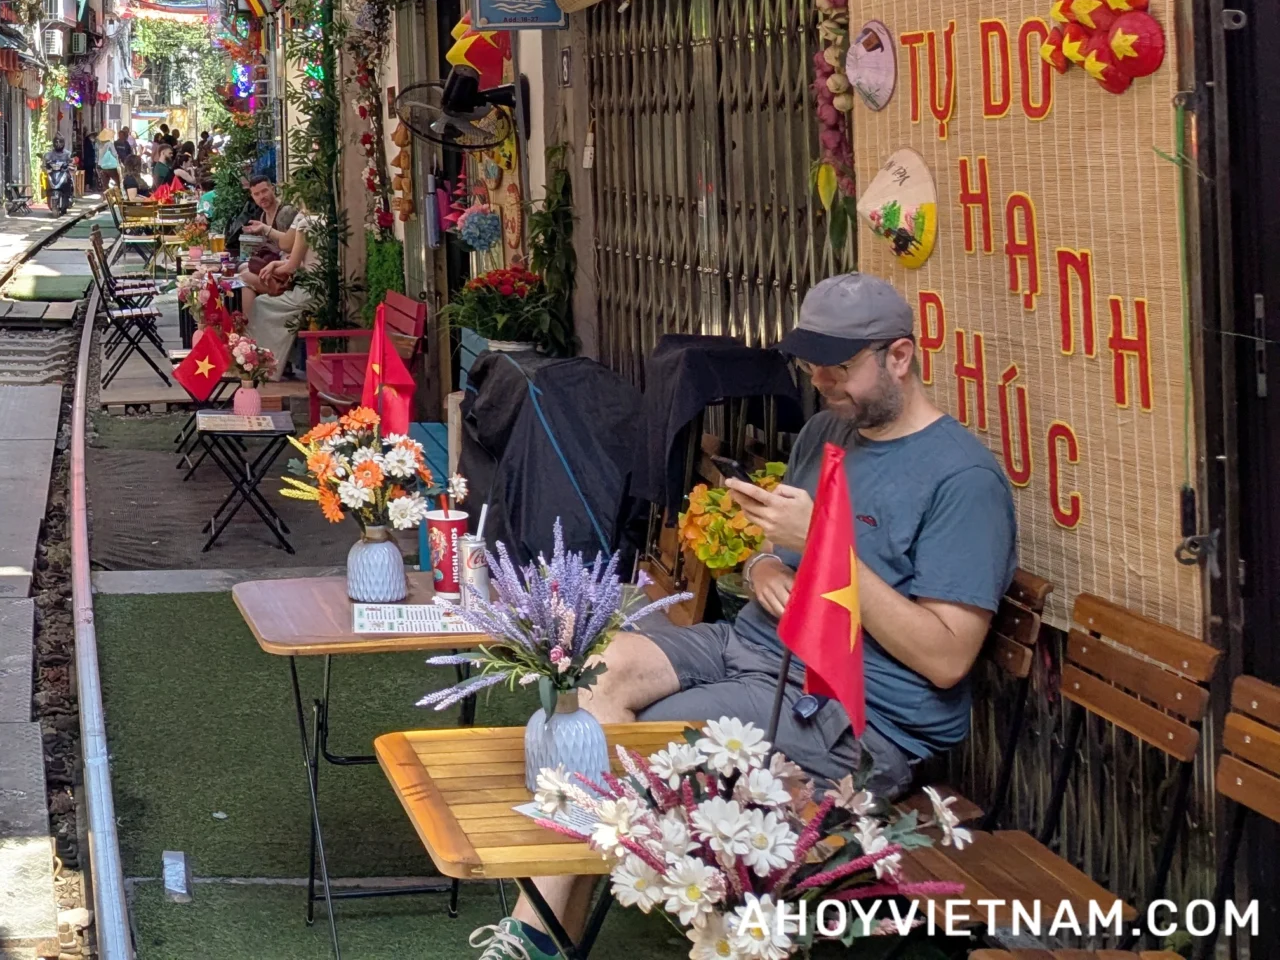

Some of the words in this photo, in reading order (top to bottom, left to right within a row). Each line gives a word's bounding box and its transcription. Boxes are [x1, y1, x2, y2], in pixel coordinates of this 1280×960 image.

[900, 19, 957, 141] TỰ
[978, 16, 1053, 122] DO
[958, 155, 1154, 414] HẠNH
[919, 290, 1083, 531] PHÚC
[451, 527, 459, 583] HIGHLANDS
